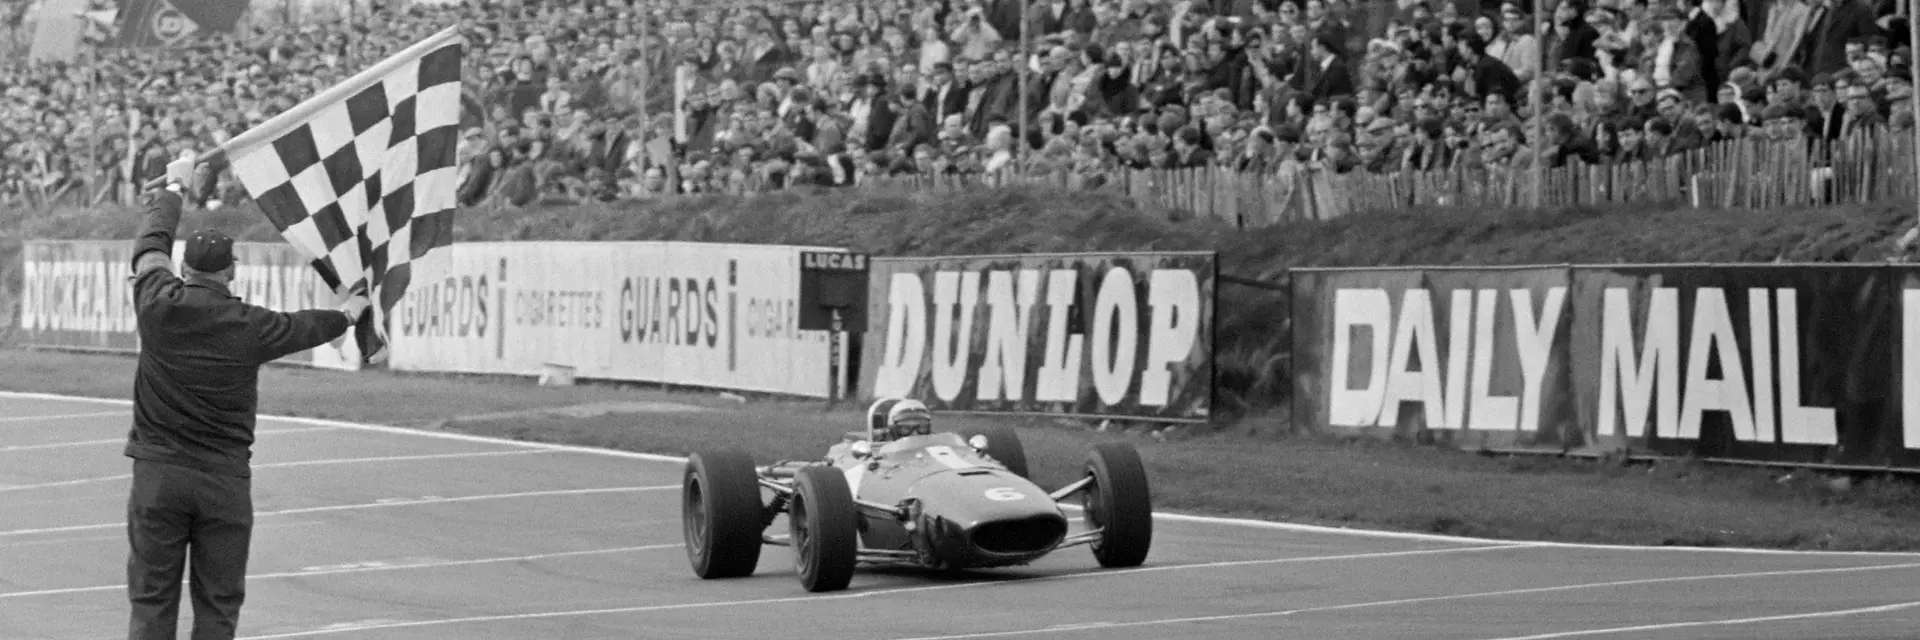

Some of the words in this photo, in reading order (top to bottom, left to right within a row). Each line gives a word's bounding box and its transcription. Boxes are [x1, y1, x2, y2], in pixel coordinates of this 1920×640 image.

[805, 253, 864, 269] LUCAS
[402, 275, 487, 338] GUARDS
[514, 289, 602, 328] CIGARETTES
[620, 277, 717, 348] GUARDS
[874, 267, 1199, 405] DUNLOP
[1329, 287, 1567, 431] DAILY
[1598, 287, 1837, 445] MAIL
[985, 487, 1026, 501] 6
